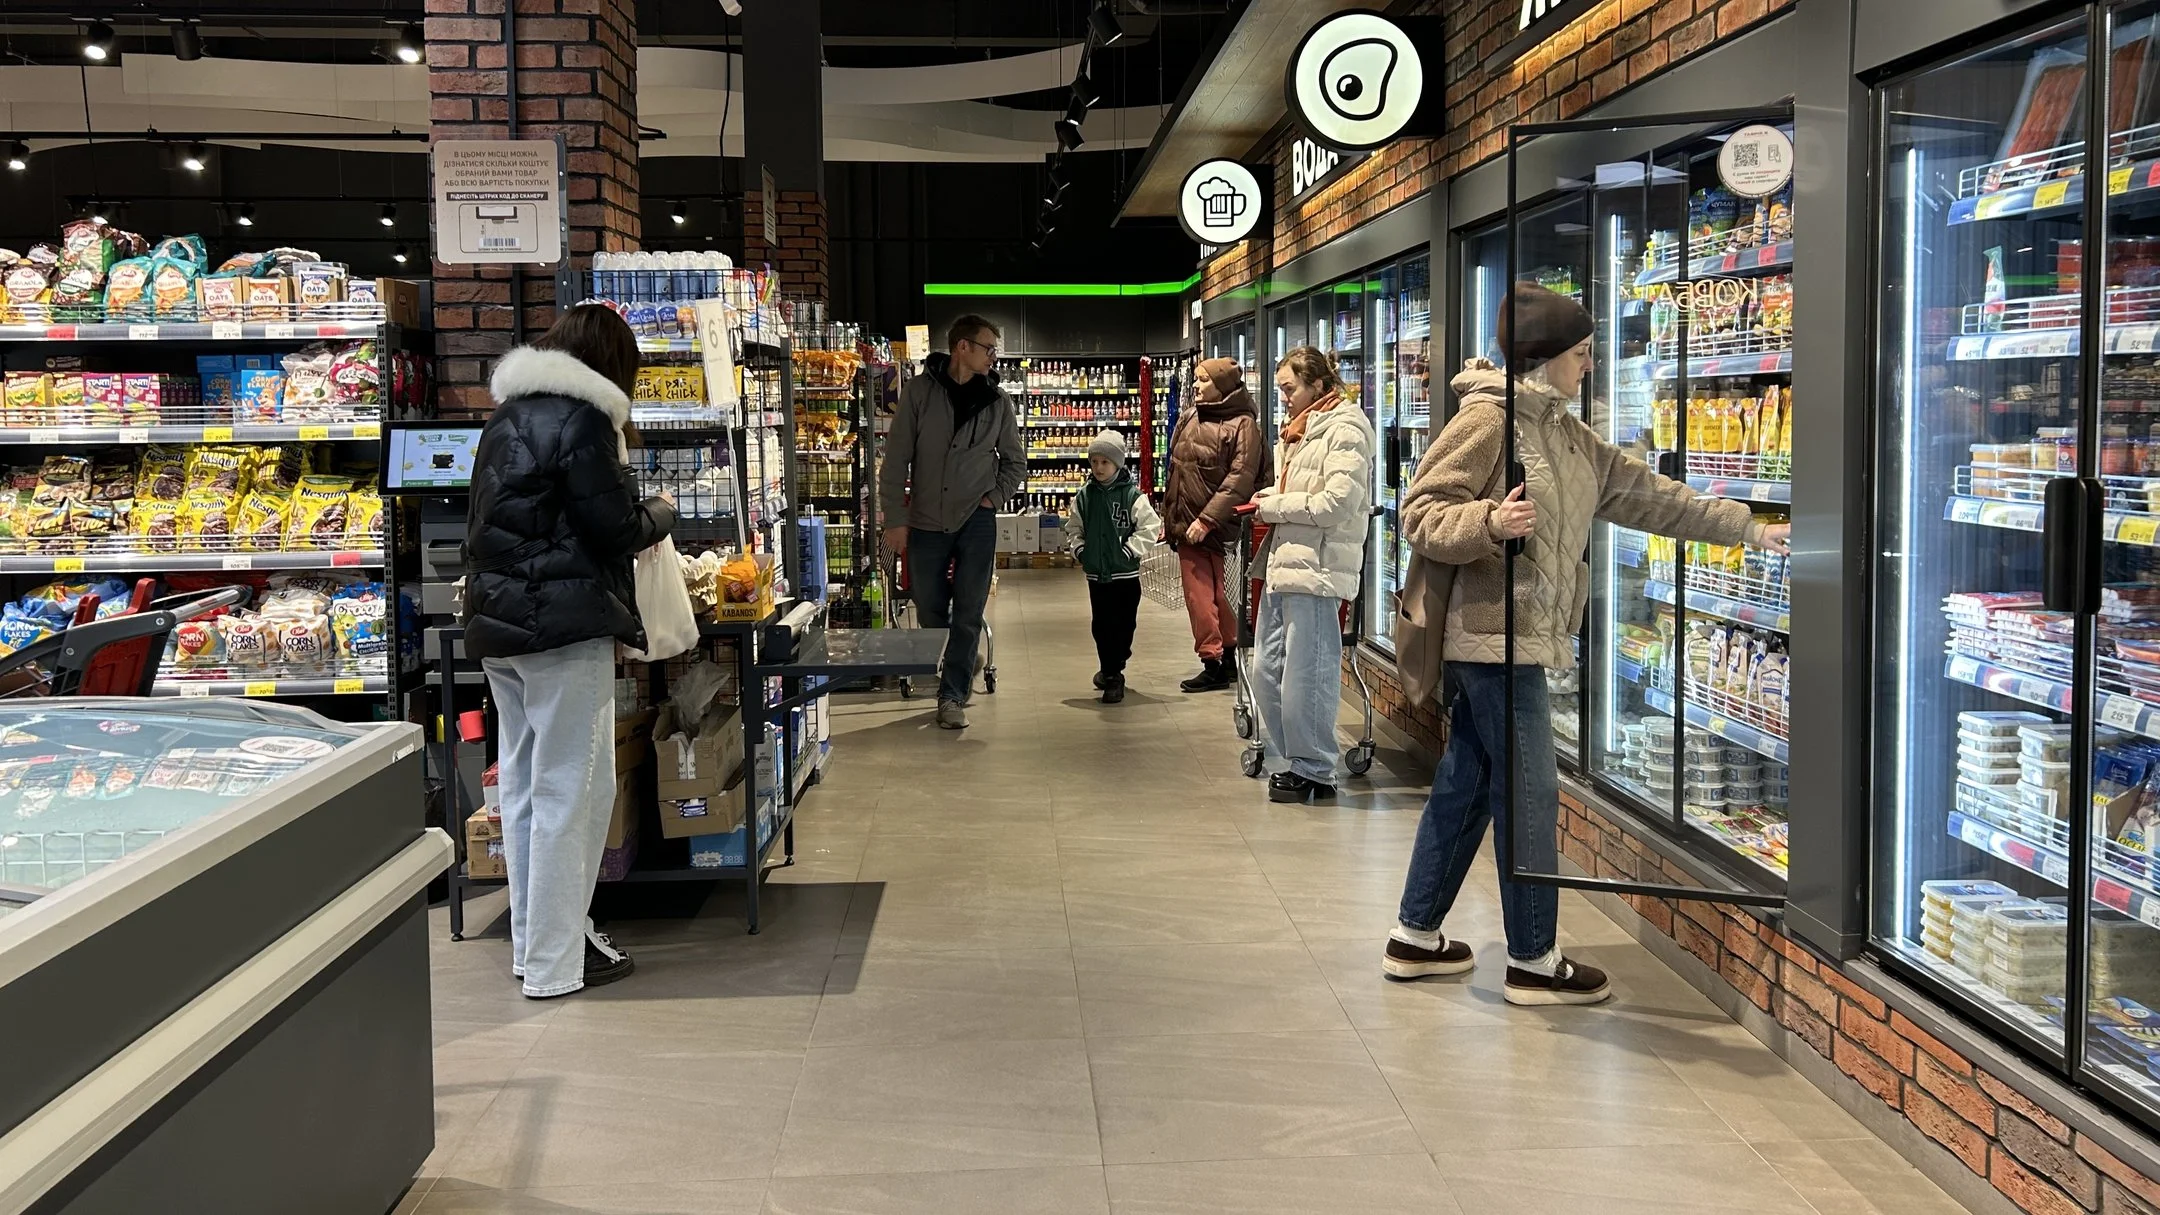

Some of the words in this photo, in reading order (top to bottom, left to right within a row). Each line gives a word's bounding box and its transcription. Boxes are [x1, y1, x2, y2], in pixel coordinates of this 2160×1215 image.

[461, 151, 486, 159] ЦЬОМУ
[488, 151, 509, 159] МІСЦІ
[443, 161, 485, 169] ДІЗНАТИСЯ
[486, 160, 518, 168] СКІЛЬКИ
[519, 160, 549, 168] КОШТУЄ
[455, 169, 490, 177] ОБРАНИЙ
[479, 179, 514, 187] ВАРТІСТЬ
[515, 179, 550, 187] ПОКУПКИ
[2130, 340, 2140, 350] 52
[636, 379, 651, 387] ЯБ
[666, 386, 698, 400] CHICK
[146, 451, 187, 463] Nesquik
[301, 487, 349, 500] Nesquik
[191, 498, 226, 511] Nesquik
[722, 608, 758, 618] KABANOSY
[4, 630, 31, 638] FLAKES
[231, 635, 258, 644] CORN
[286, 636, 314, 646] CORN
[2111, 710, 2124, 721] 215
